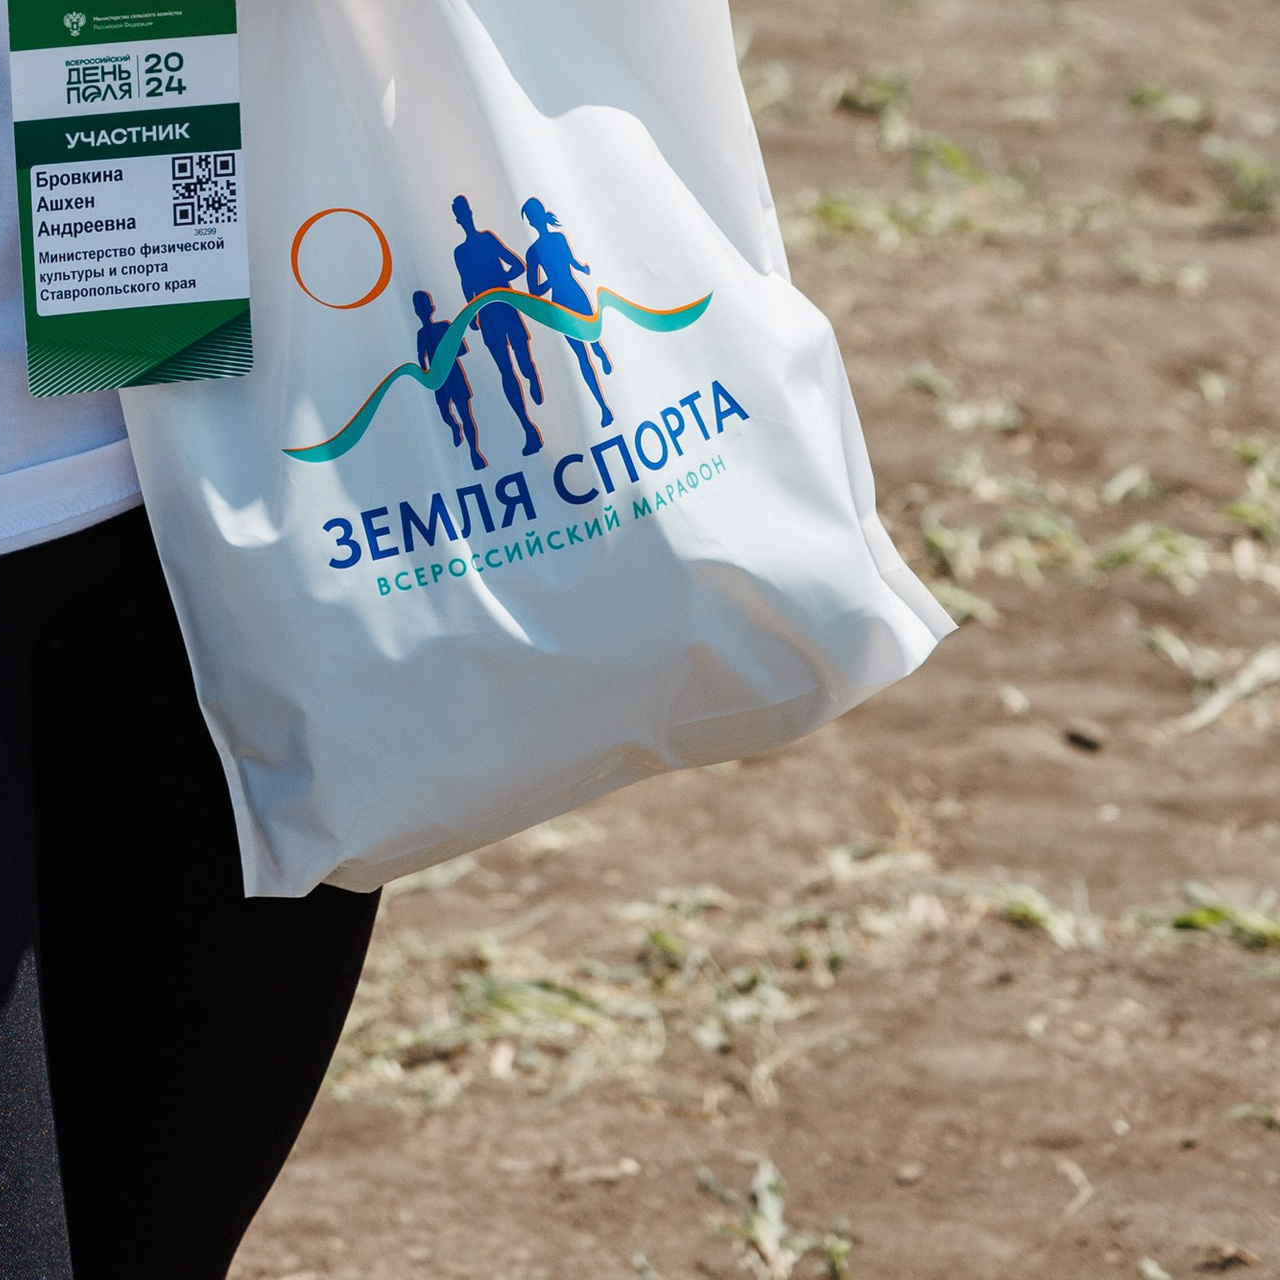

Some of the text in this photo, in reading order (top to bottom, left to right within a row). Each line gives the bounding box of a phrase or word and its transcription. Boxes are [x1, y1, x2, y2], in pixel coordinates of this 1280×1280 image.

[65, 54, 130, 66] ВСЕРОССИЙСКИЙ
[145, 52, 184, 74] 20
[66, 64, 131, 85] ДЕНЬ
[66, 82, 132, 104] ПОЛЯ
[146, 75, 187, 97] 24
[65, 123, 190, 149] УЧАСТНИК
[36, 167, 124, 190] Бровкина
[36, 194, 95, 212] Ашхен
[37, 215, 137, 237] Андреевна
[39, 237, 225, 264] Министерство физической
[40, 262, 169, 285] культуры и спорта
[40, 278, 196, 301] Ставропольского края
[322, 379, 750, 570] ЗЕМЛЯ СПОРТА
[376, 454, 727, 597] ВСЕРОССИЙСКИЙ МАРАФОН
